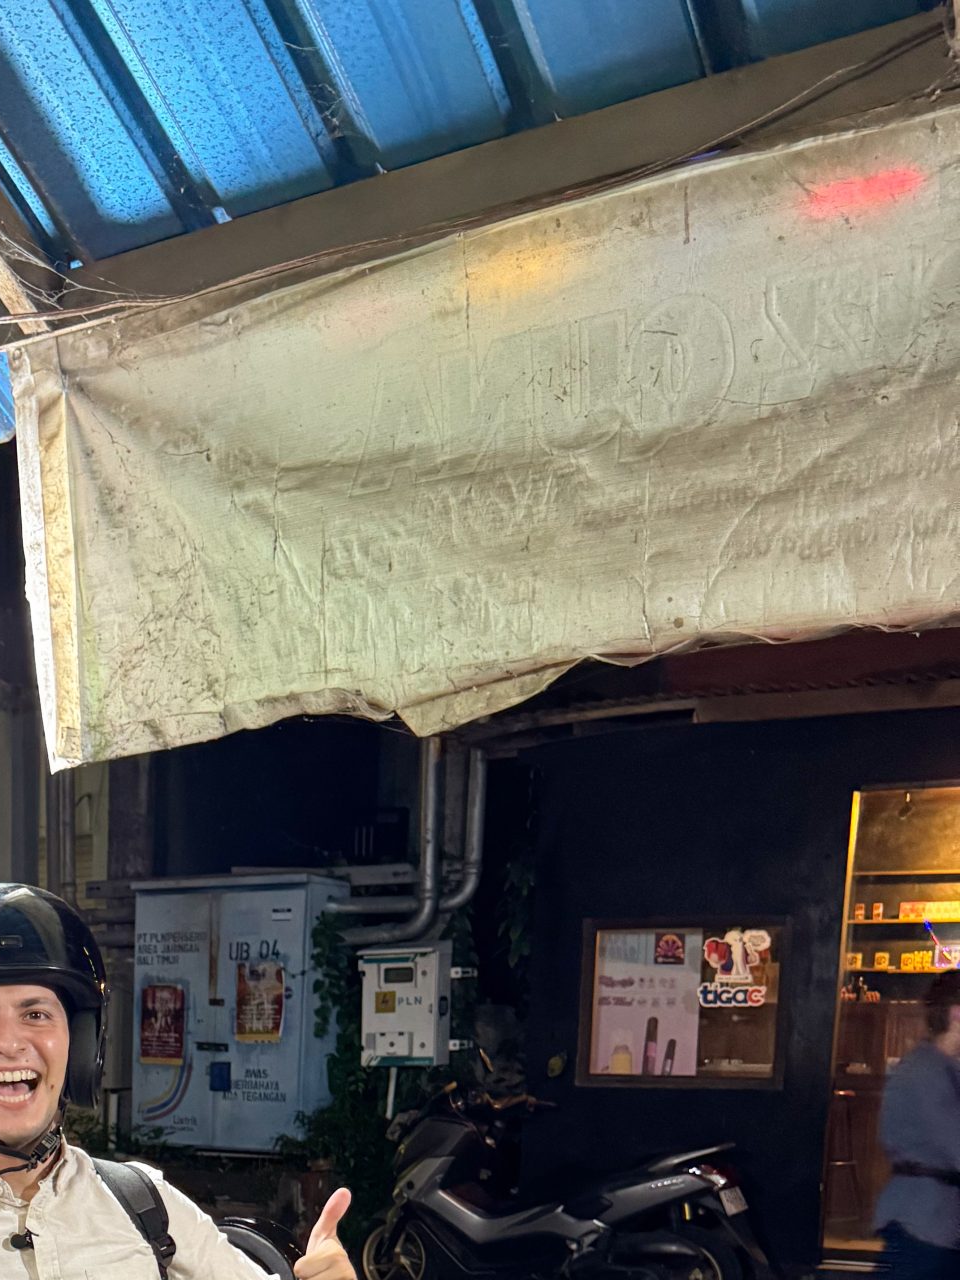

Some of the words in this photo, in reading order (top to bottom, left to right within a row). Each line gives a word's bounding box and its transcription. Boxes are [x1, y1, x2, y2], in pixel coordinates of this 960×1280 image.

[228, 941, 250, 961] UB
[259, 939, 280, 960] 04
[397, 996, 423, 1006] PLN
